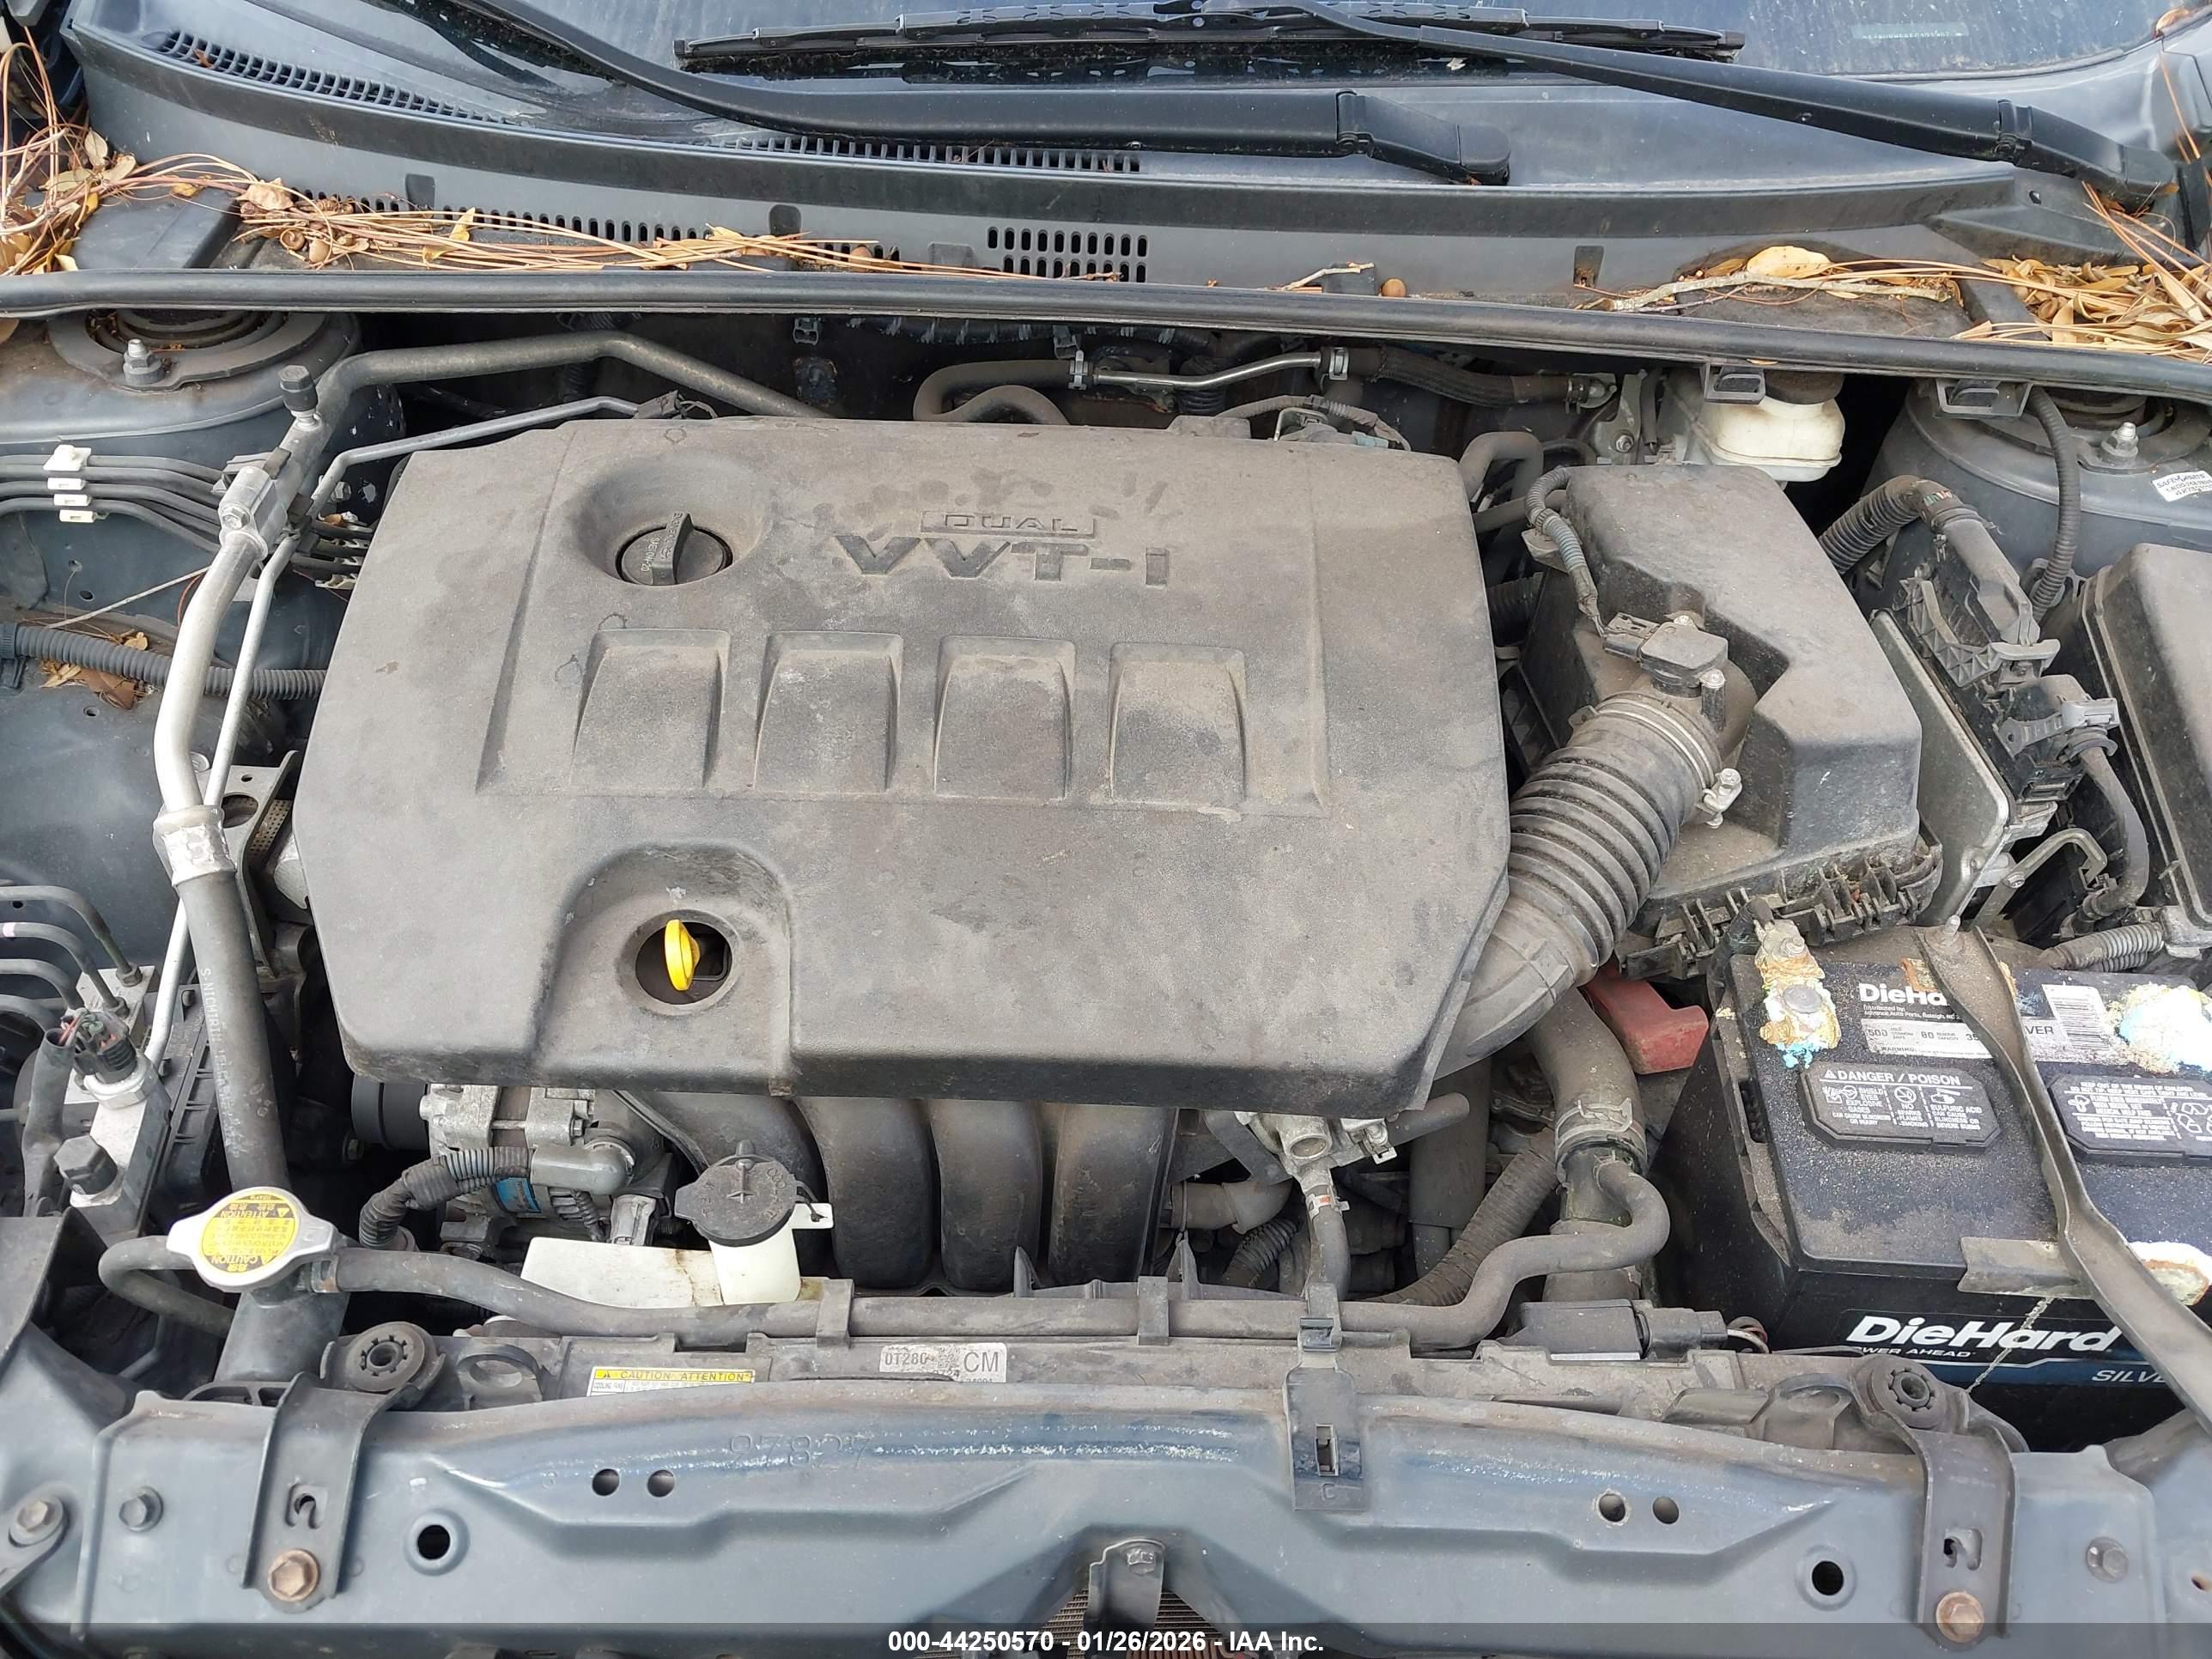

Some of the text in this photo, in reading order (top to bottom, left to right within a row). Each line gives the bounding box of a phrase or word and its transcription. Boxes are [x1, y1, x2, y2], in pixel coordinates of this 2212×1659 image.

[945, 514, 1079, 532] DUAL
[1858, 982, 1950, 1006] DieHa
[1868, 1029, 1888, 1037] 500
[1838, 1070, 1895, 1082] DANGER
[1908, 1073, 1960, 1085] POISON
[211, 1255, 258, 1264] CAUTION
[1845, 1316, 2122, 1352] DieHard
[1906, 1348, 1972, 1357] AHEAD
[963, 1352, 999, 1372] CM
[620, 1371, 744, 1381] CAUTION ATTENTION
